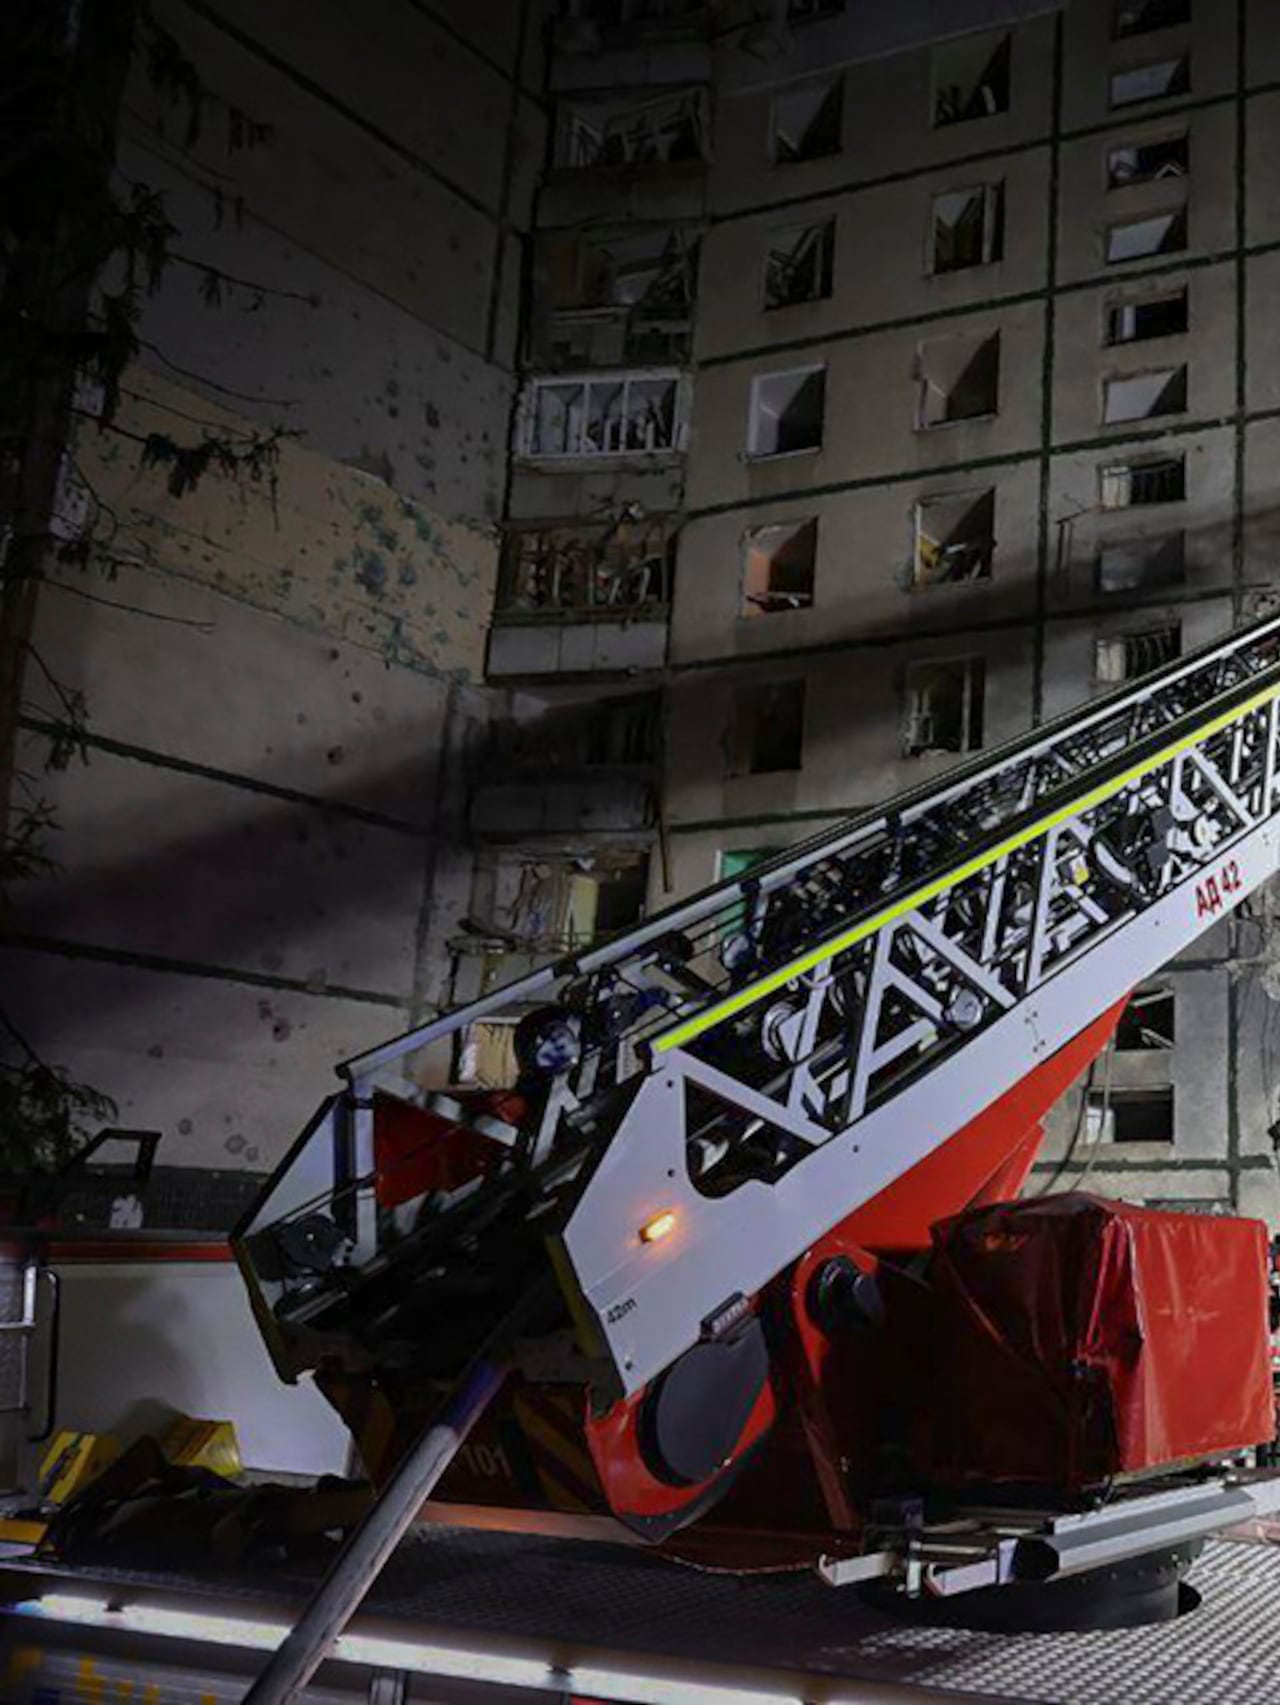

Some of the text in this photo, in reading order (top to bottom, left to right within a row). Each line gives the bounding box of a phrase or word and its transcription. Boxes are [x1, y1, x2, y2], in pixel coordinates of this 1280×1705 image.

[1195, 860, 1242, 917] АД 42
[607, 1298, 638, 1324] 42m
